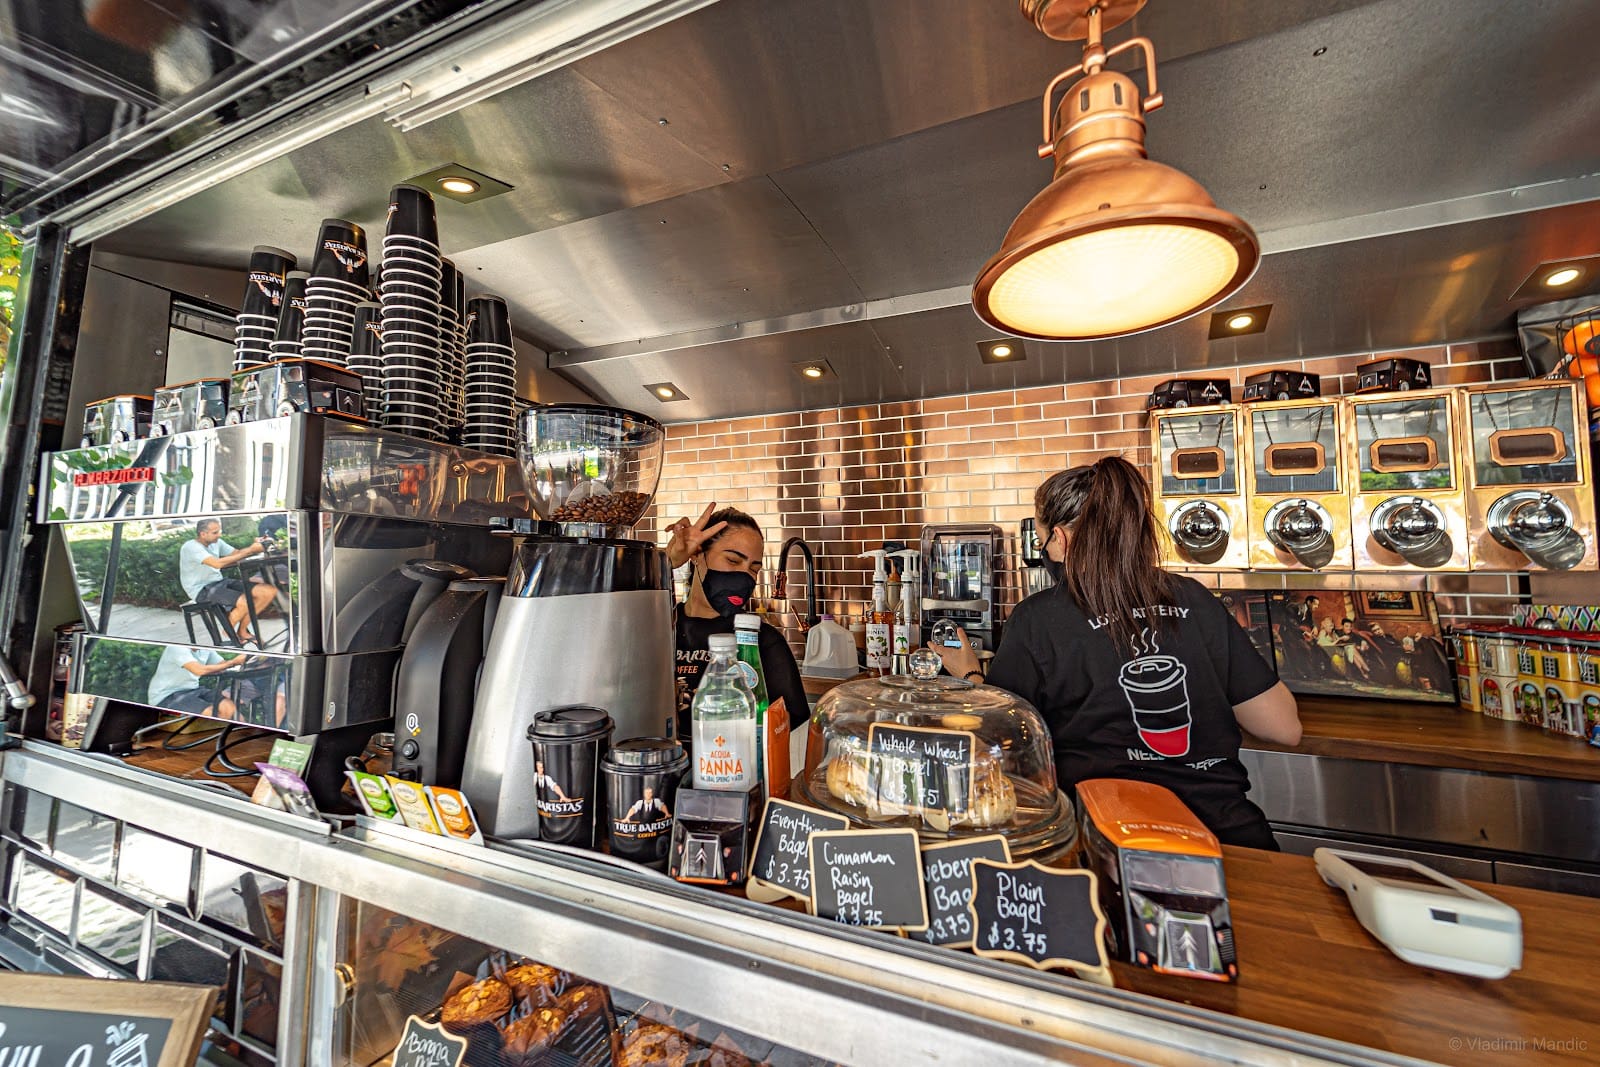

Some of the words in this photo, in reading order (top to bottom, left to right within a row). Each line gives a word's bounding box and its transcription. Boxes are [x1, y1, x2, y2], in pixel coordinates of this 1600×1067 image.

[1132, 604, 1190, 619] ATTERY
[879, 733, 916, 754] Whole
[699, 757, 743, 775] PANNA
[892, 758, 931, 783] Bagel
[613, 821, 637, 834] TRUE
[779, 834, 810, 864] Bagel
[823, 841, 896, 866] Cinnamon
[831, 867, 873, 890] Raisin
[996, 872, 1047, 906] Plain
[837, 887, 873, 910] Bagel
[933, 885, 973, 912] Bag
[996, 896, 1042, 933] Bagel
